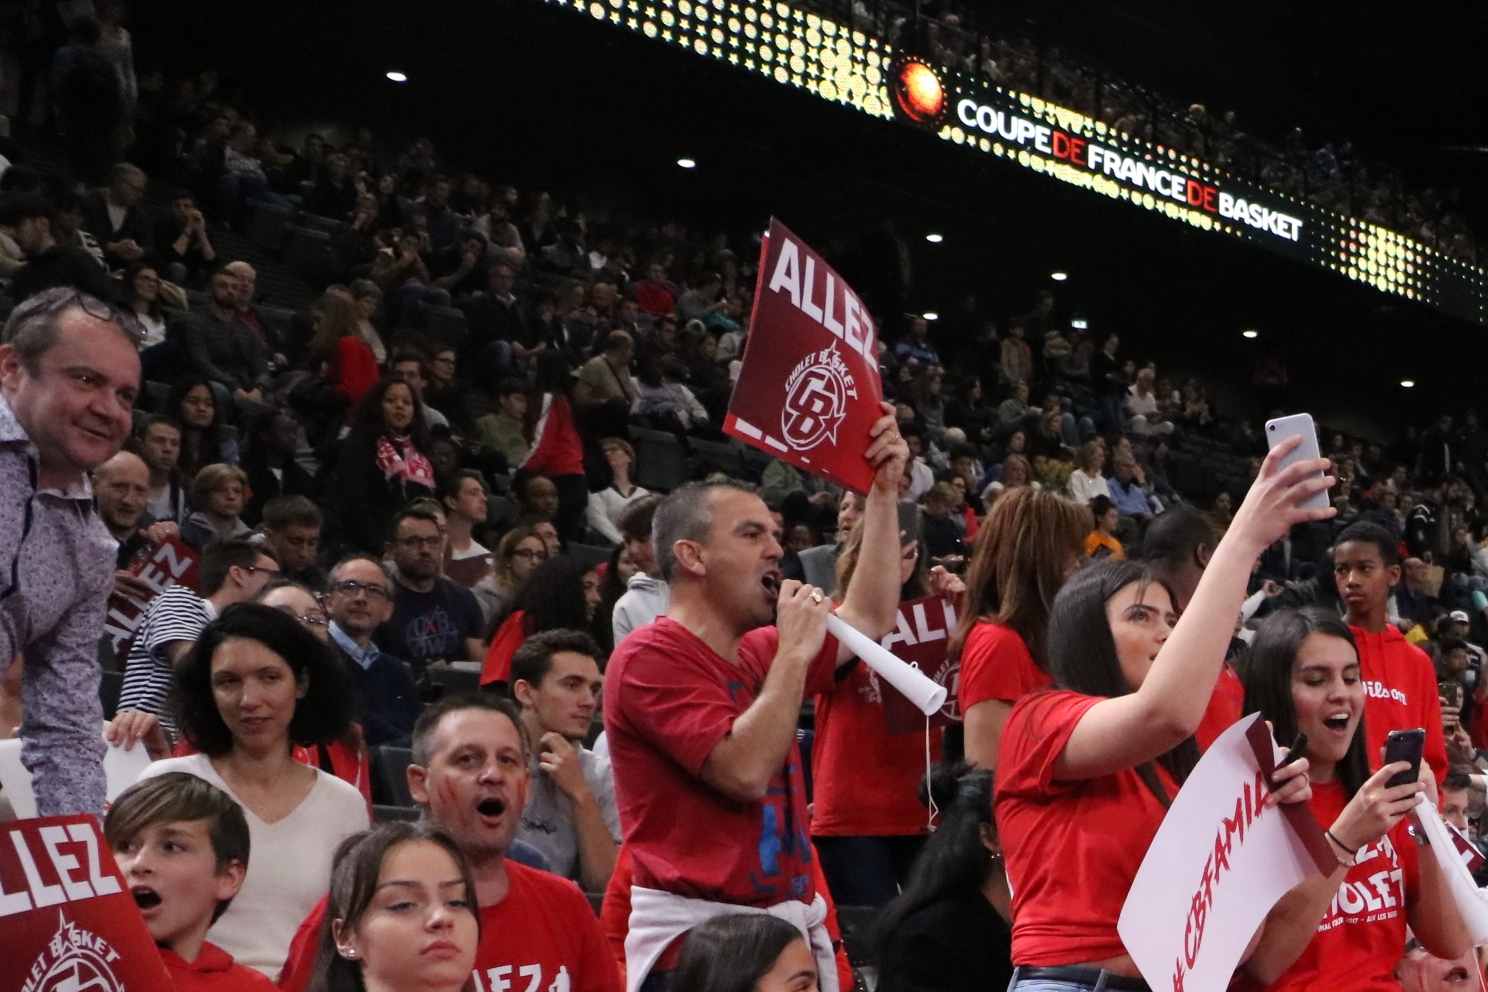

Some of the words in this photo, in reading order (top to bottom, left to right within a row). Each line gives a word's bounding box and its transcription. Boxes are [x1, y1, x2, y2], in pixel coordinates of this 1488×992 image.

[957, 98, 1053, 155] COUPE
[1052, 130, 1086, 166] DE
[1087, 144, 1187, 202] FRANCE
[1187, 179, 1219, 213] DE
[1218, 192, 1303, 242] BASKET
[769, 238, 878, 374] ALLEZ
[0, 823, 122, 917] LLEZ
[1324, 868, 1405, 917] OLET
